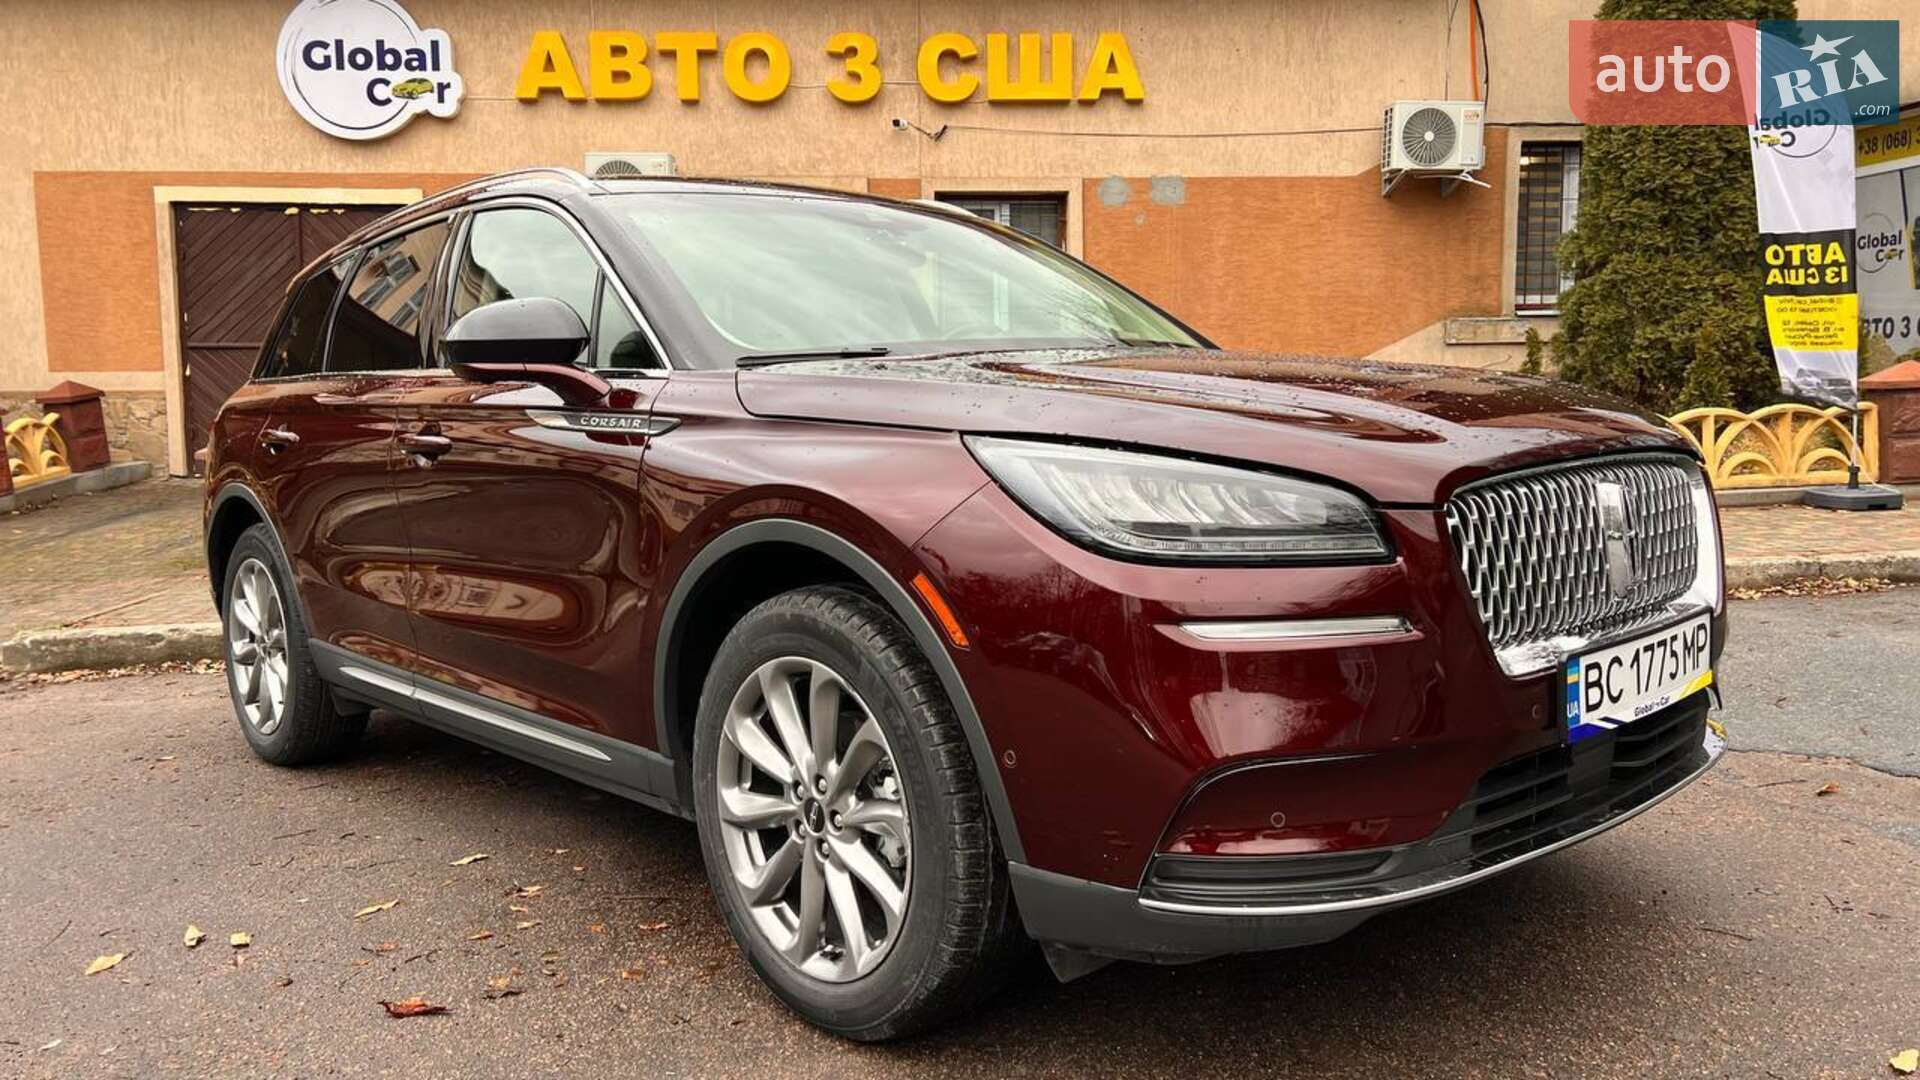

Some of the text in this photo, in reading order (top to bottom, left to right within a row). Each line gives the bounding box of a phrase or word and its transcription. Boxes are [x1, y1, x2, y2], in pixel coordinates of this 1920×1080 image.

[302, 38, 441, 72] Global
[516, 30, 1146, 104] АВТО З США
[366, 77, 451, 107] Cr
[1857, 230, 1903, 250] Global
[1875, 248, 1905, 263] Cr
[580, 416, 641, 428] CORSAIR
[1585, 622, 1708, 713] BC 1775 MP
